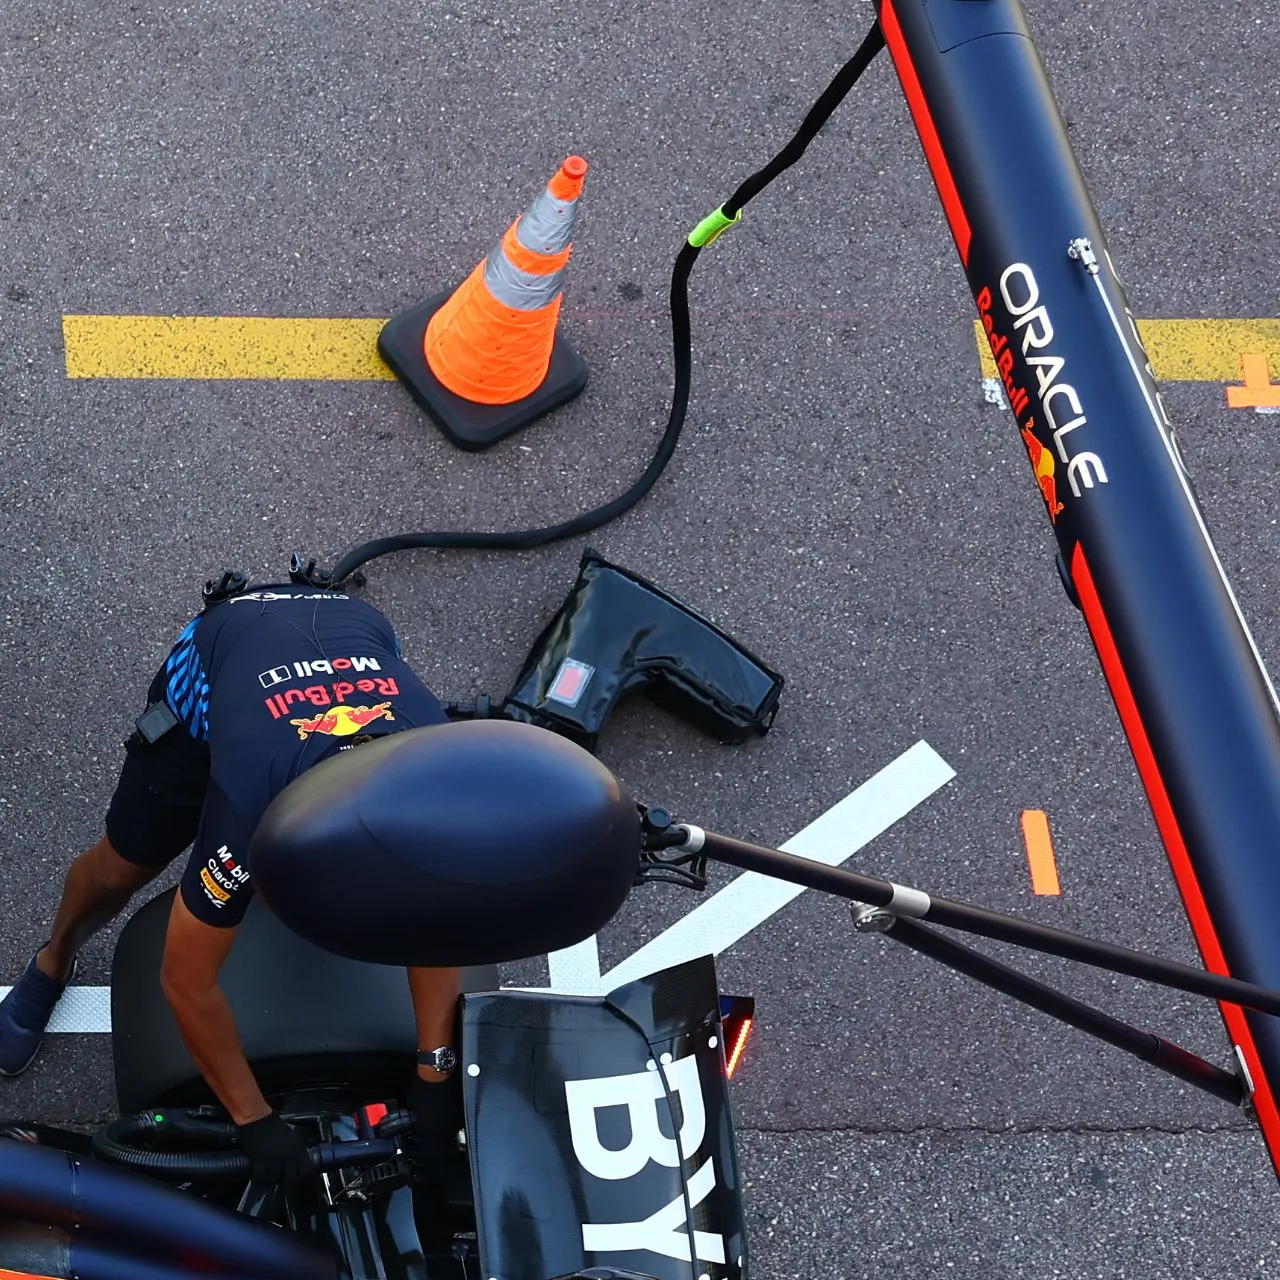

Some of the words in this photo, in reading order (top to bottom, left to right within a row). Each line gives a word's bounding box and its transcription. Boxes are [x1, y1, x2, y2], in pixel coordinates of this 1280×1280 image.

[977, 286, 1008, 356] Red
[999, 262, 1109, 498] ORACLE
[296, 656, 381, 678] Mobil
[266, 685, 331, 719] Bull
[332, 677, 400, 703] Red
[207, 858, 234, 890] Claro
[216, 845, 250, 884] Mobil
